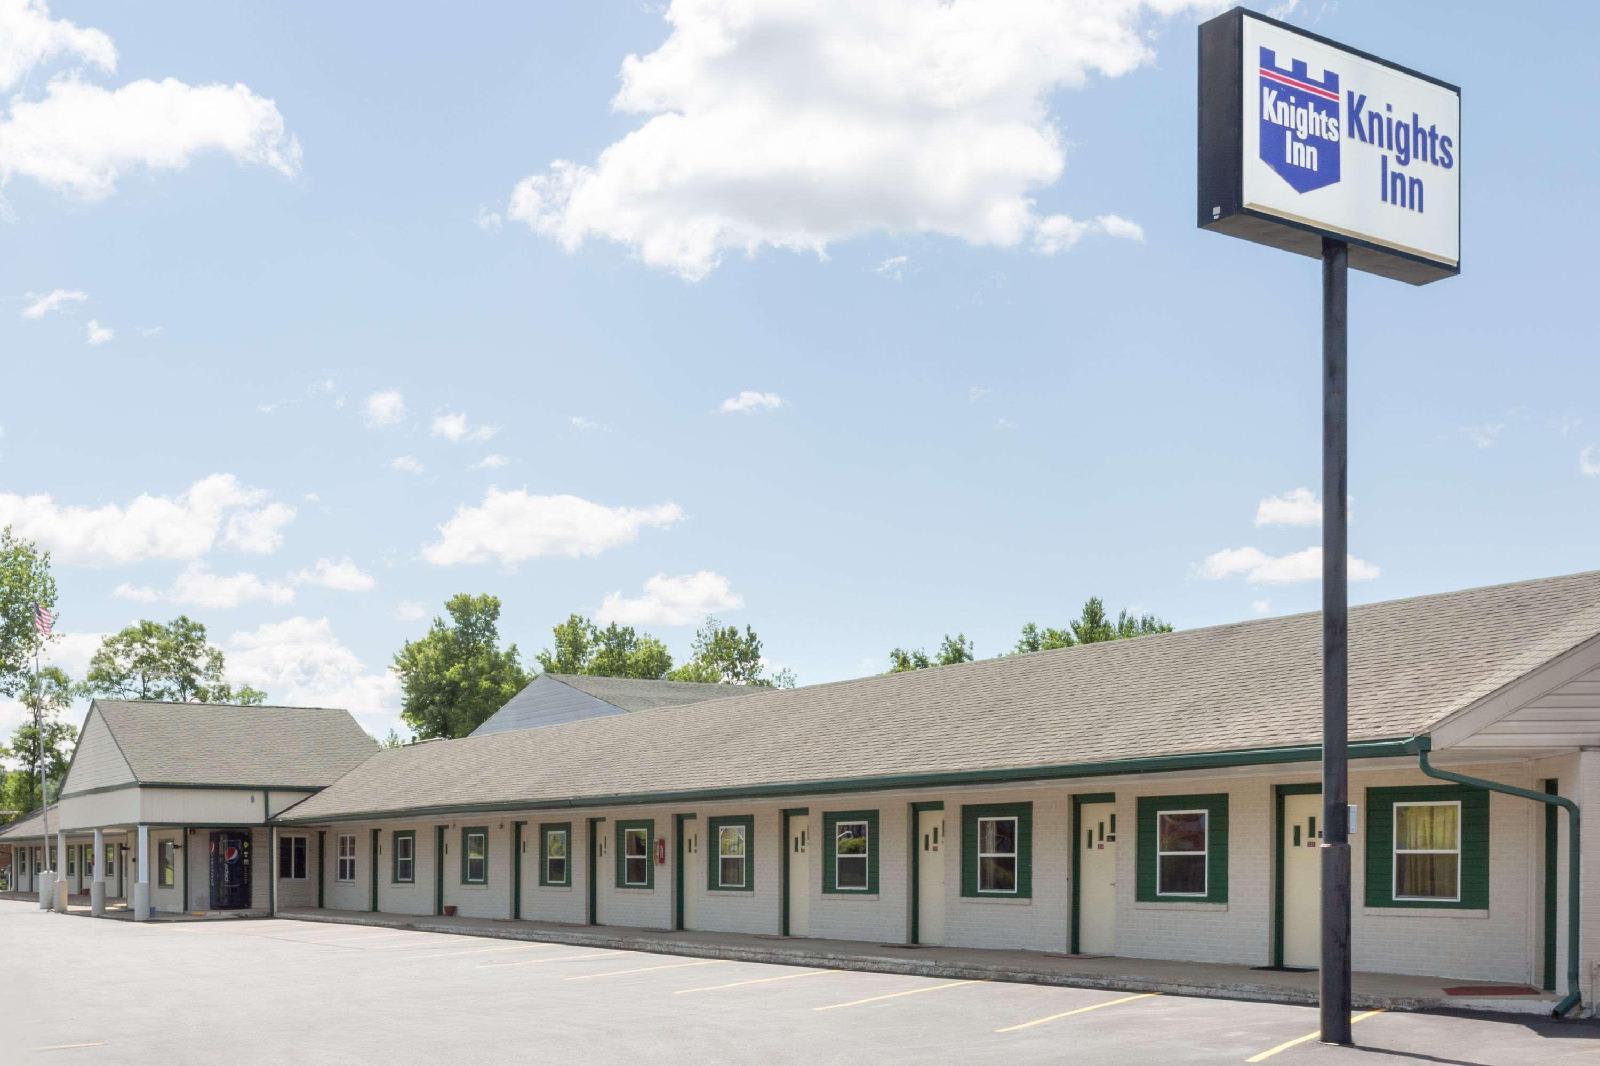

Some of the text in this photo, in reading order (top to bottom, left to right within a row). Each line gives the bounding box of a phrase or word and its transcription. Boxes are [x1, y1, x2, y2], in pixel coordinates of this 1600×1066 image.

[1262, 86, 1339, 142] Knights
[1347, 90, 1454, 169] Knights
[1285, 130, 1318, 172] Inn
[1381, 154, 1424, 214] Inn
